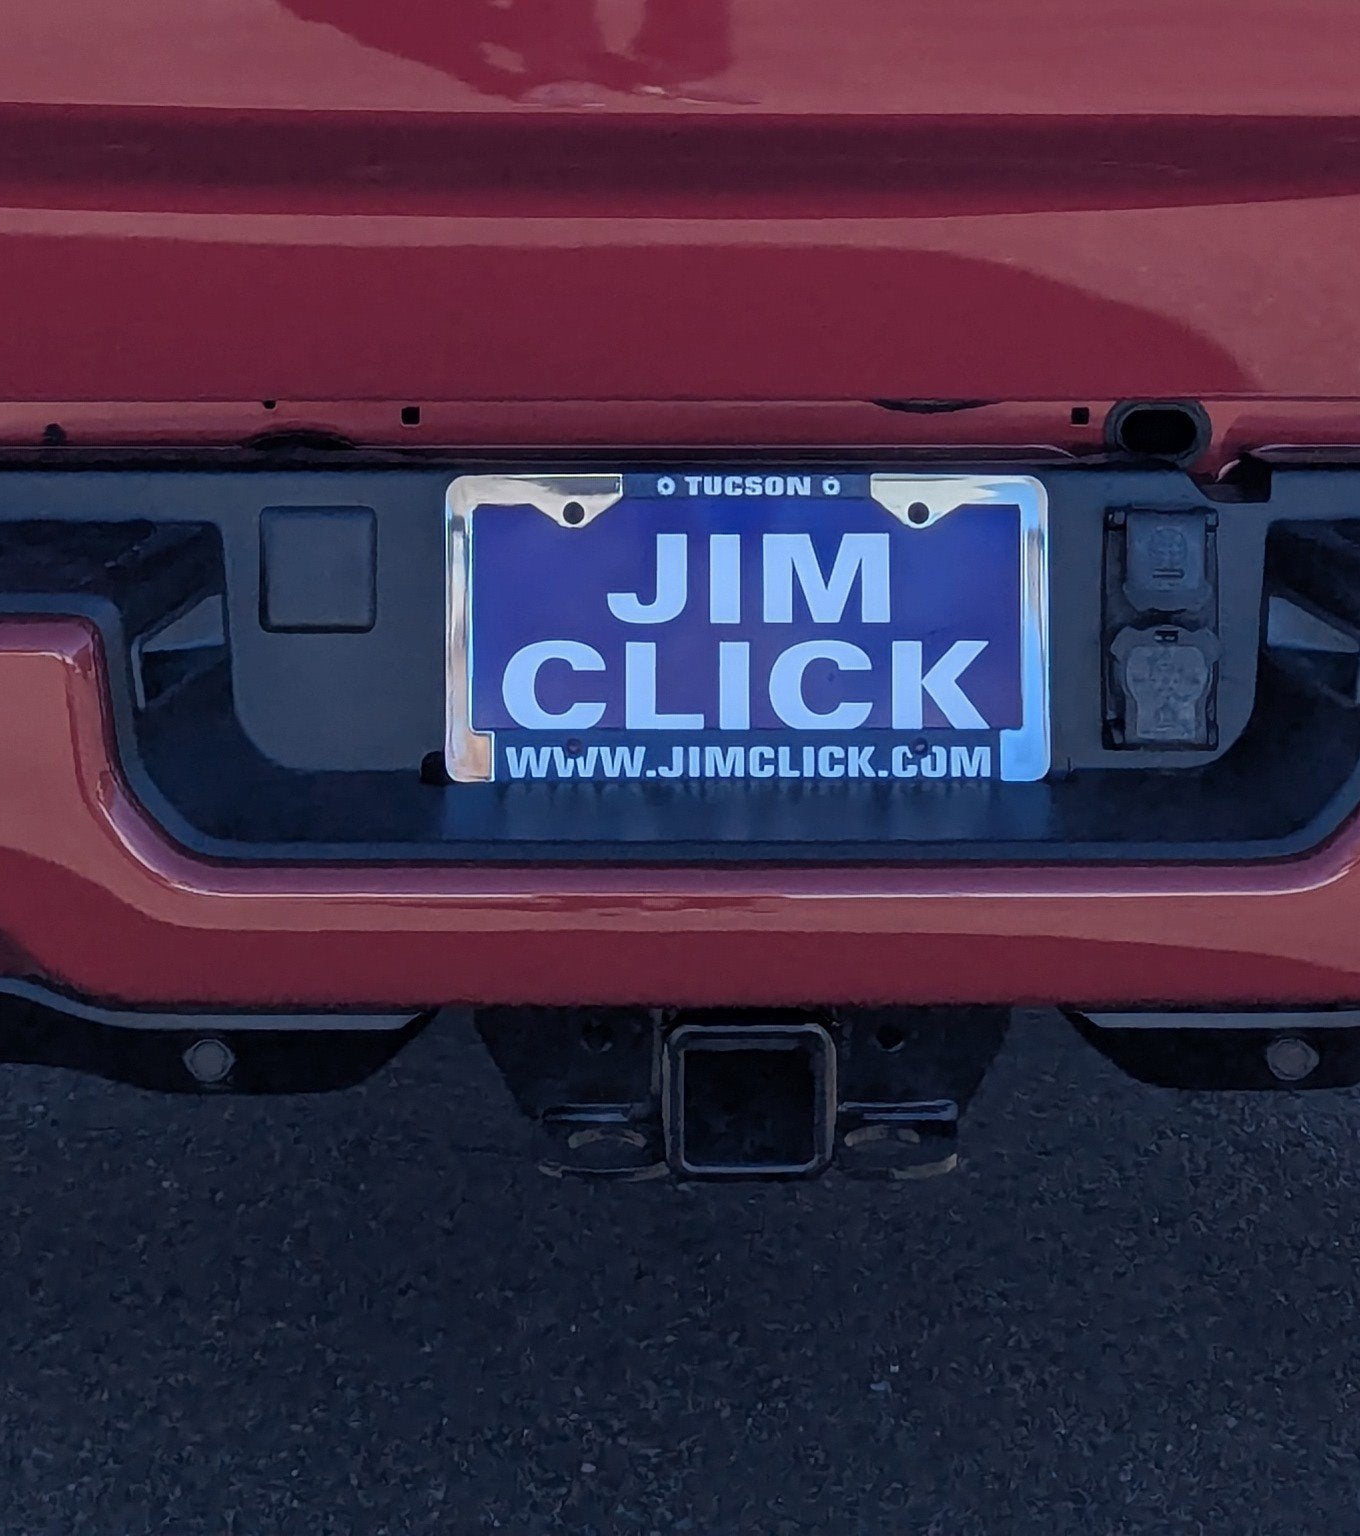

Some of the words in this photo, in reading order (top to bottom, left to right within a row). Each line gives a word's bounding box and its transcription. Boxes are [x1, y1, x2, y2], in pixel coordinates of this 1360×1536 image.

[684, 475, 812, 497] TUCSON
[606, 533, 891, 624] JIM
[501, 639, 991, 730] CLICK
[505, 745, 992, 779] WWW.JIMCLICK.COM
